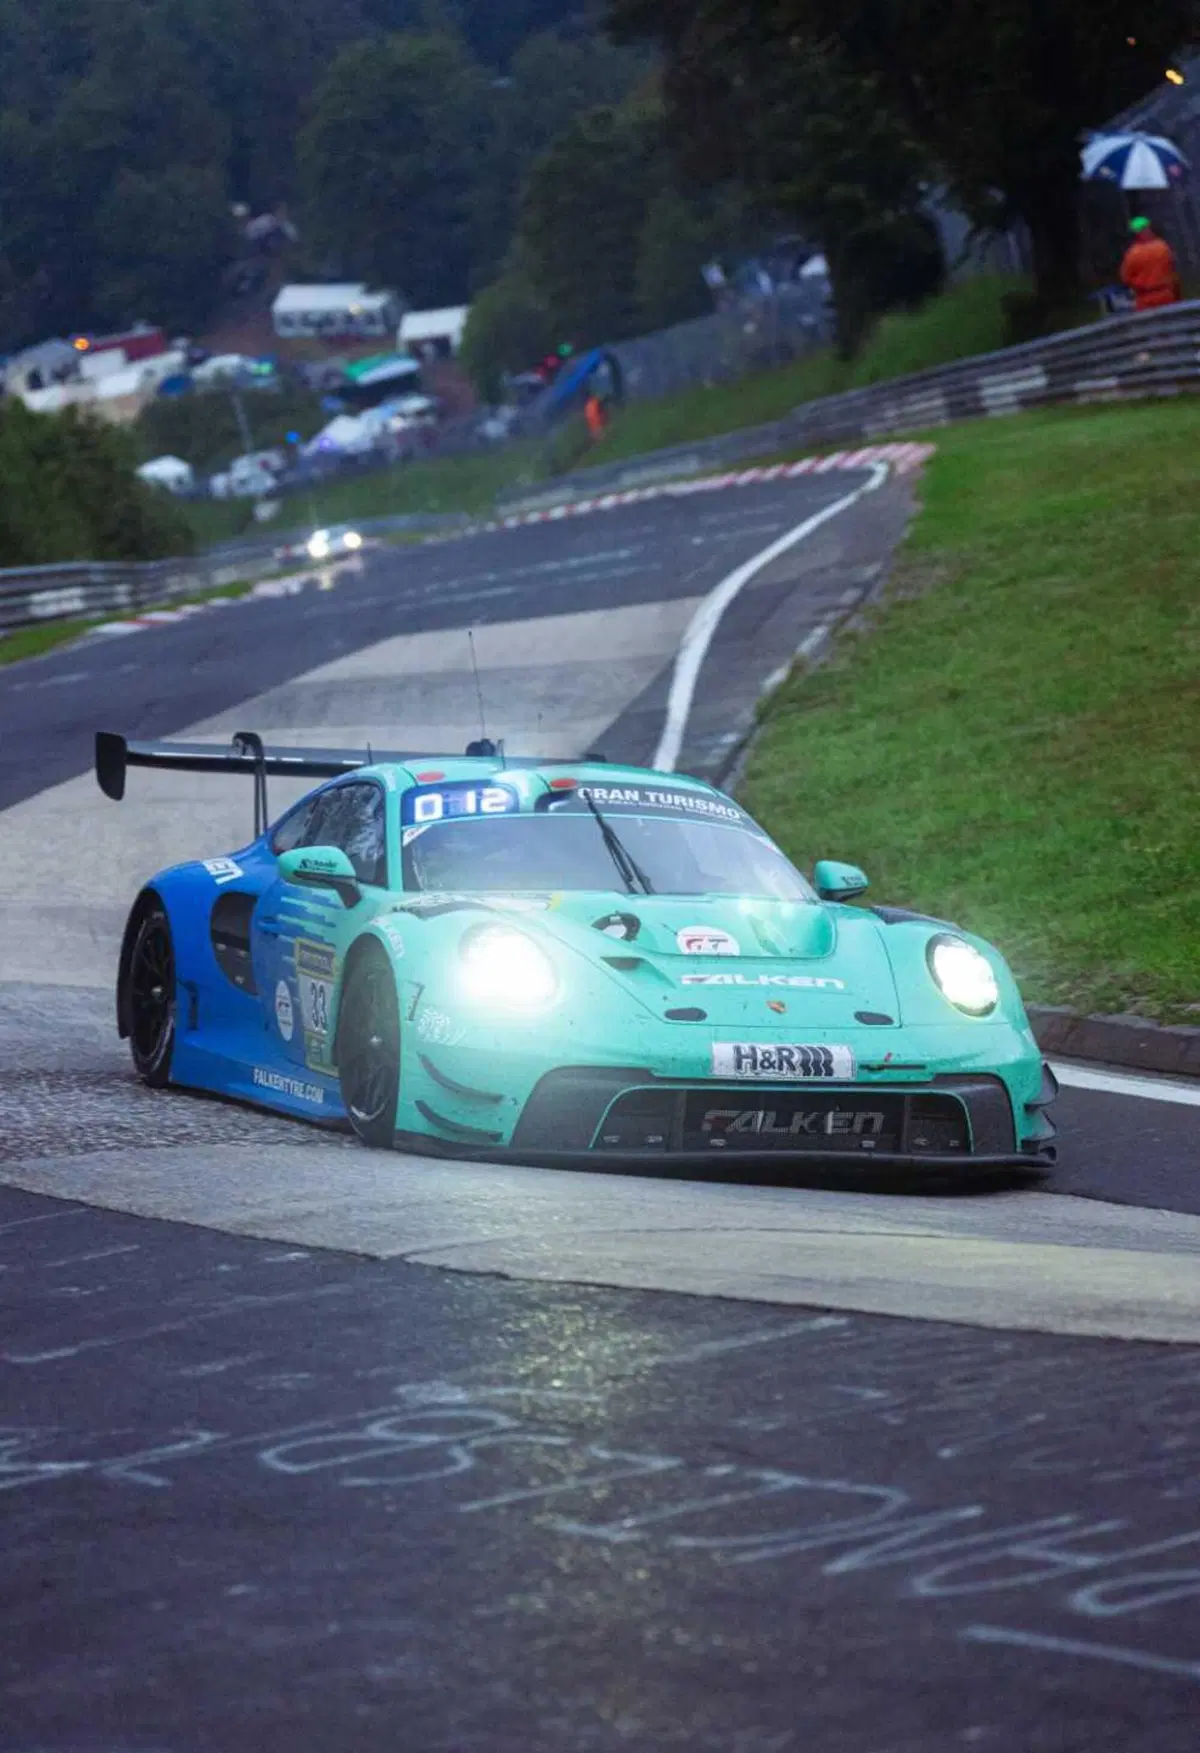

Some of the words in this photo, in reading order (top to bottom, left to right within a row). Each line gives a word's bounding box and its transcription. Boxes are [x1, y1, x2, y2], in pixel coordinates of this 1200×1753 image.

[577, 787, 640, 803] GRAN
[644, 790, 743, 821] TURISMO
[681, 973, 845, 990] FALKEN
[734, 1045, 797, 1075] H&R
[701, 1108, 885, 1134] FALKEN
